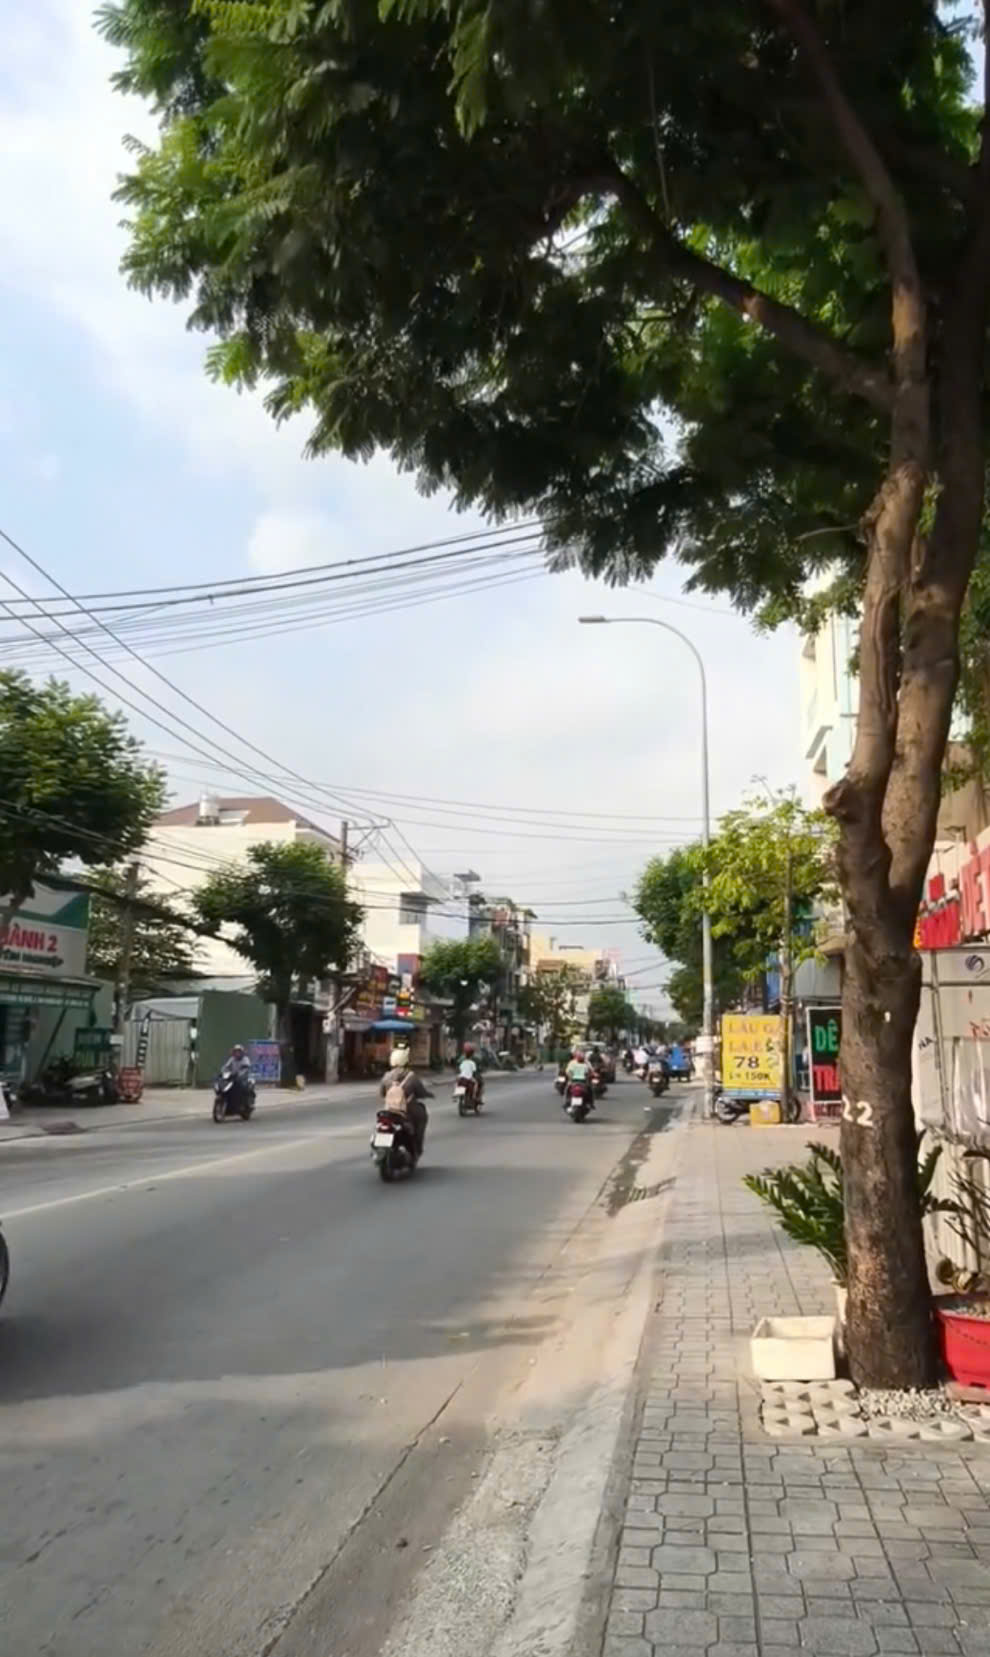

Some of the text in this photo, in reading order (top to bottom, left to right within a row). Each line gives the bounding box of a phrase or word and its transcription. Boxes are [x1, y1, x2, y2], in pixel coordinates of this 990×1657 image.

[47, 934, 58, 952] 2
[814, 1018, 838, 1052] DÊ
[734, 1055, 760, 1068] 78
